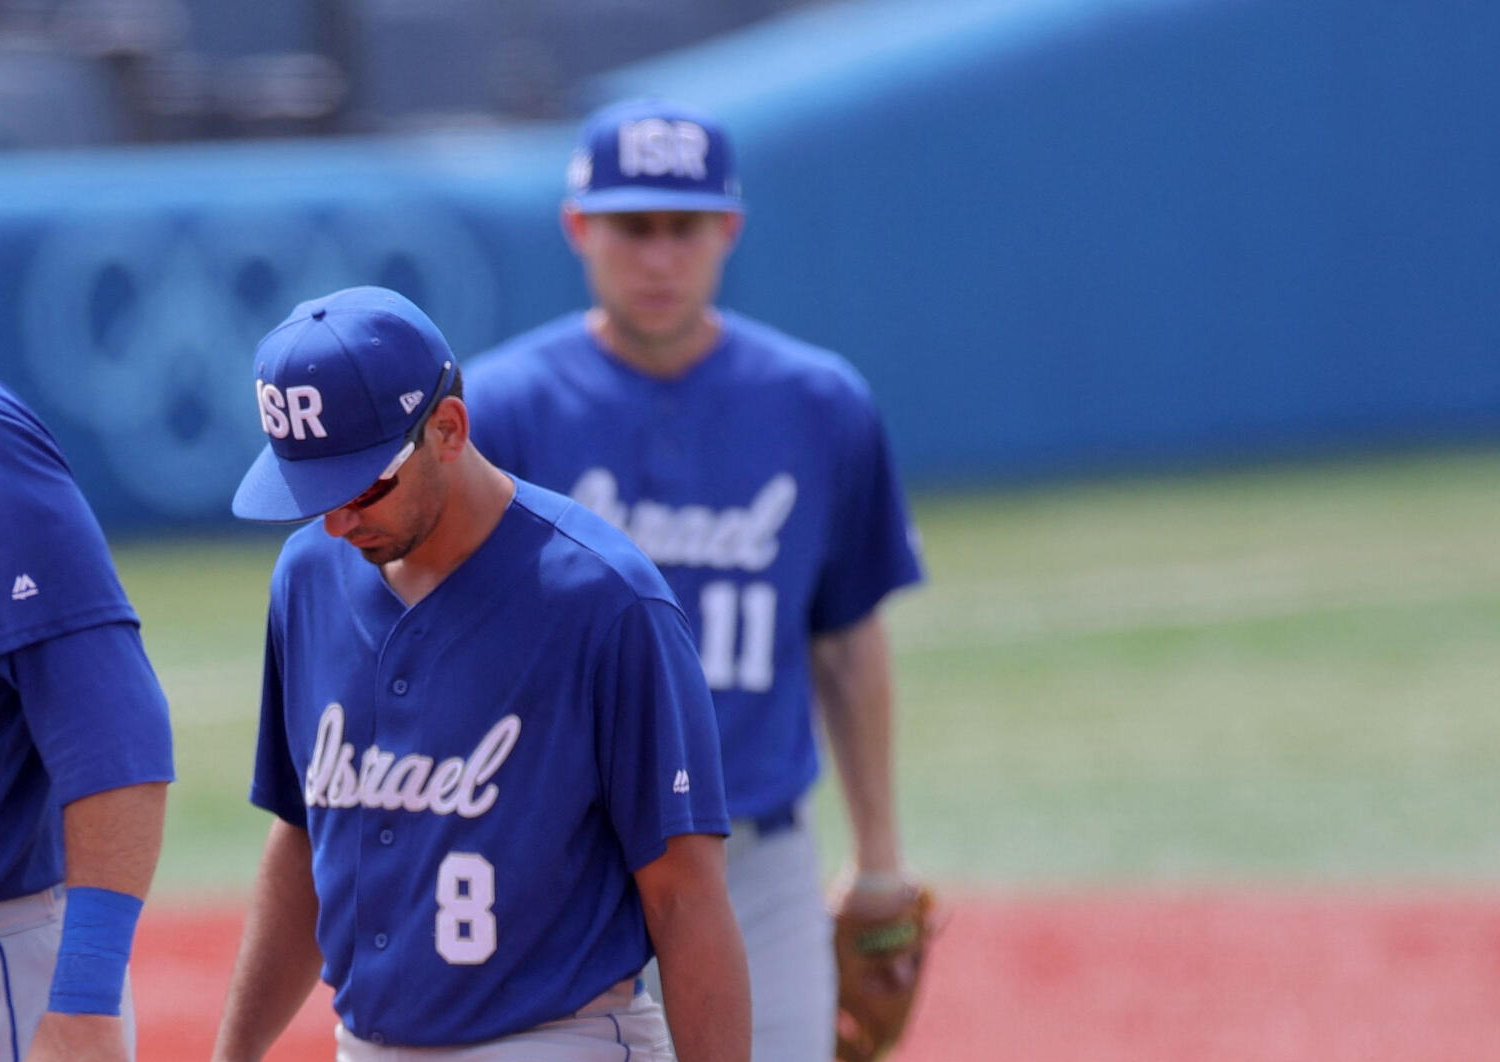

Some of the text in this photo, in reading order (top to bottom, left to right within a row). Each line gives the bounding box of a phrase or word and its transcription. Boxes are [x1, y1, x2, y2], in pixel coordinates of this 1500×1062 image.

[619, 118, 709, 181] ISR
[701, 580, 778, 692] 11
[305, 702, 522, 819] Israel
[435, 852, 498, 966] 8
